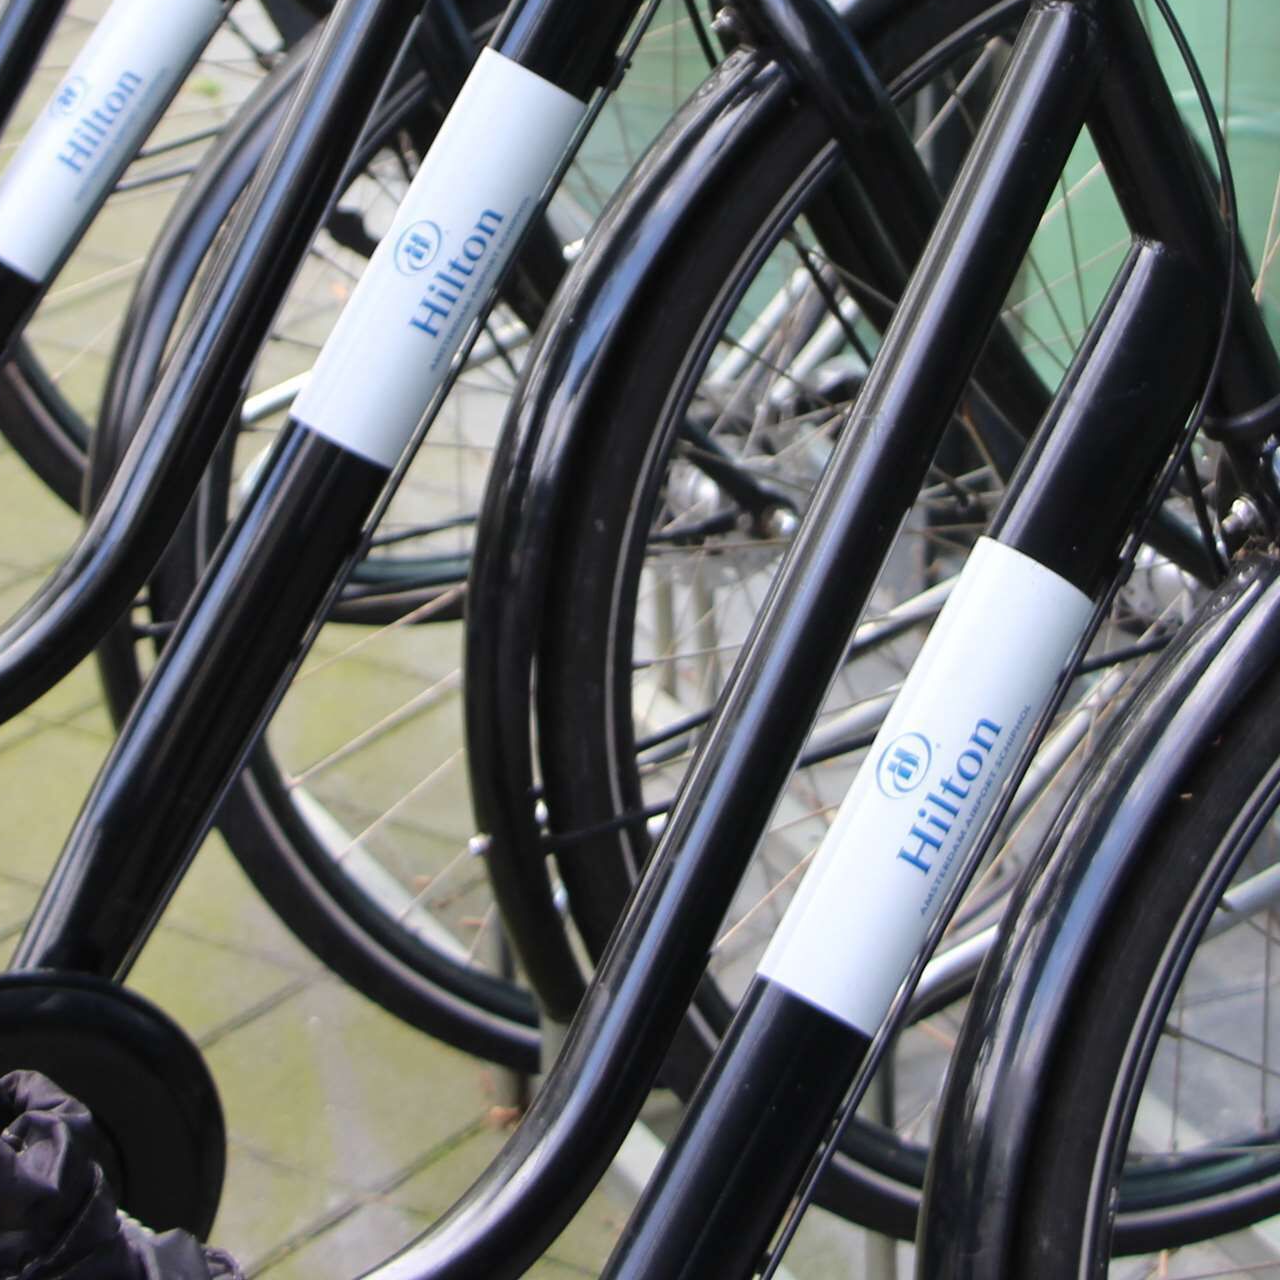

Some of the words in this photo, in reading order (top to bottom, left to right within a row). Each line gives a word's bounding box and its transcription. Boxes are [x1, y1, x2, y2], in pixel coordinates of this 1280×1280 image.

[56, 71, 144, 173] Hilton
[409, 208, 504, 338] Hilton
[896, 718, 1003, 876] Hilton
[920, 830, 967, 916] AMSTERDAM
[965, 770, 997, 828] AIRPORT
[995, 703, 1032, 768] SCHIPHOL
